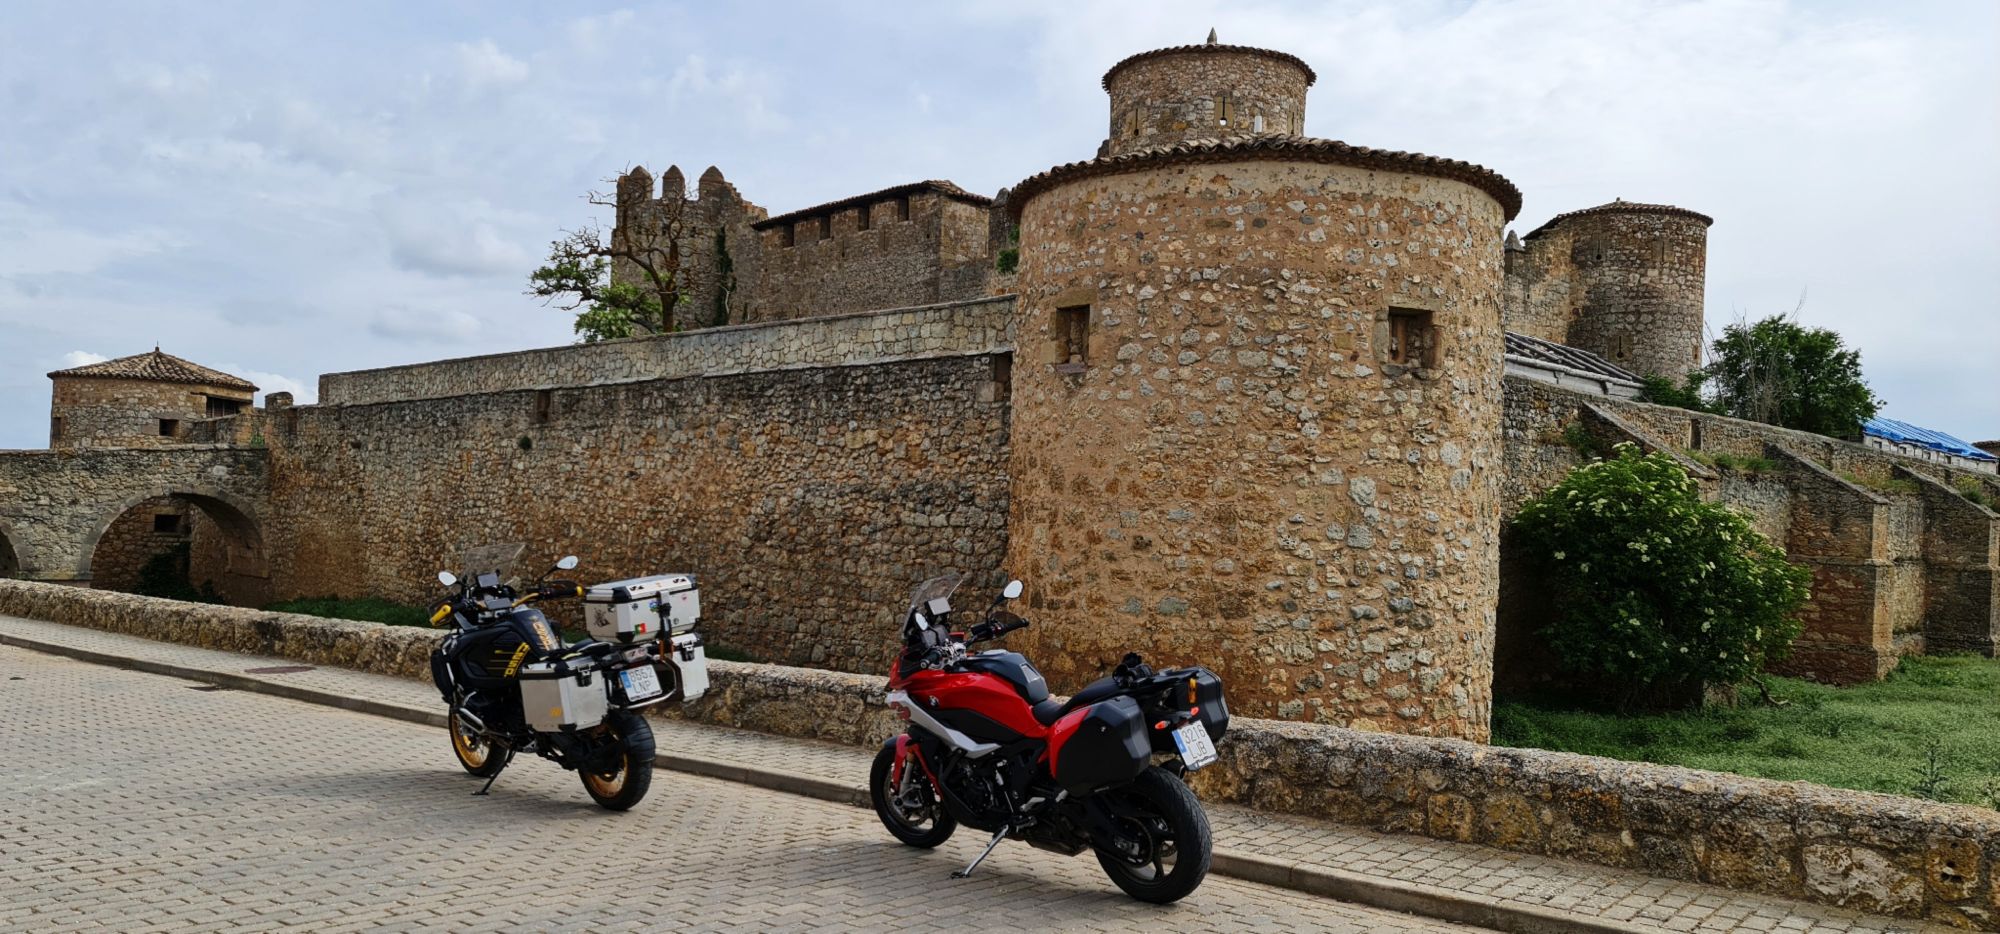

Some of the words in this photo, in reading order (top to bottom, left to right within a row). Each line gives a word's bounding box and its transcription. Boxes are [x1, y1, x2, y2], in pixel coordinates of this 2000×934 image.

[632, 680, 651, 693] LNP
[1182, 725, 1205, 744] 3216
[1188, 741, 1207, 759] LJB
